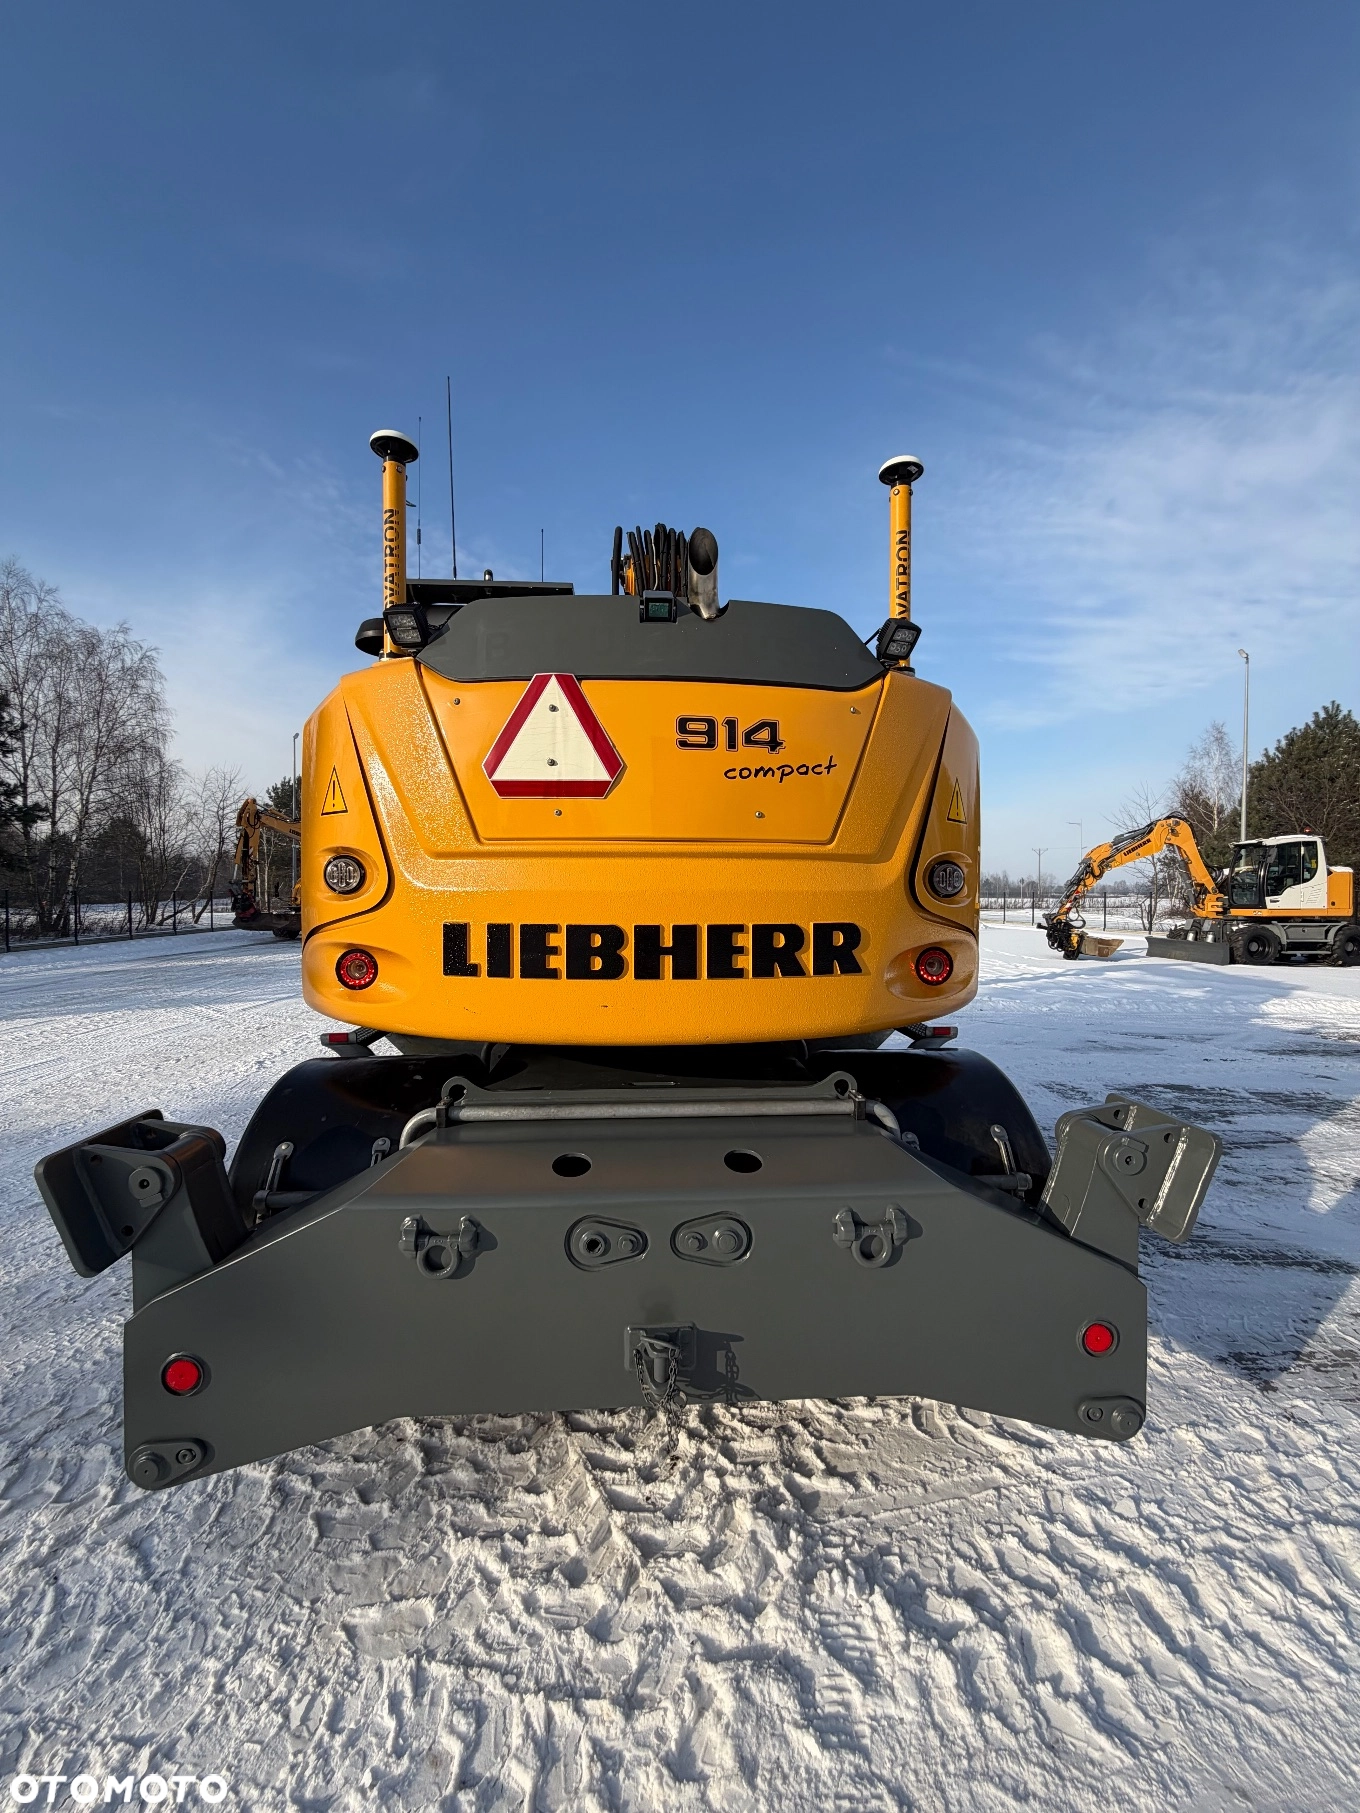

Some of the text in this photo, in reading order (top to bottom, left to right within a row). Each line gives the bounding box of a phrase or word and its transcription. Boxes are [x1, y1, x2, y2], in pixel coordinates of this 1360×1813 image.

[383, 508, 400, 634] VATRON
[896, 530, 911, 620] VATRON
[676, 715, 786, 754] 914
[724, 755, 837, 783] compact
[442, 922, 864, 980] LIEBHERR
